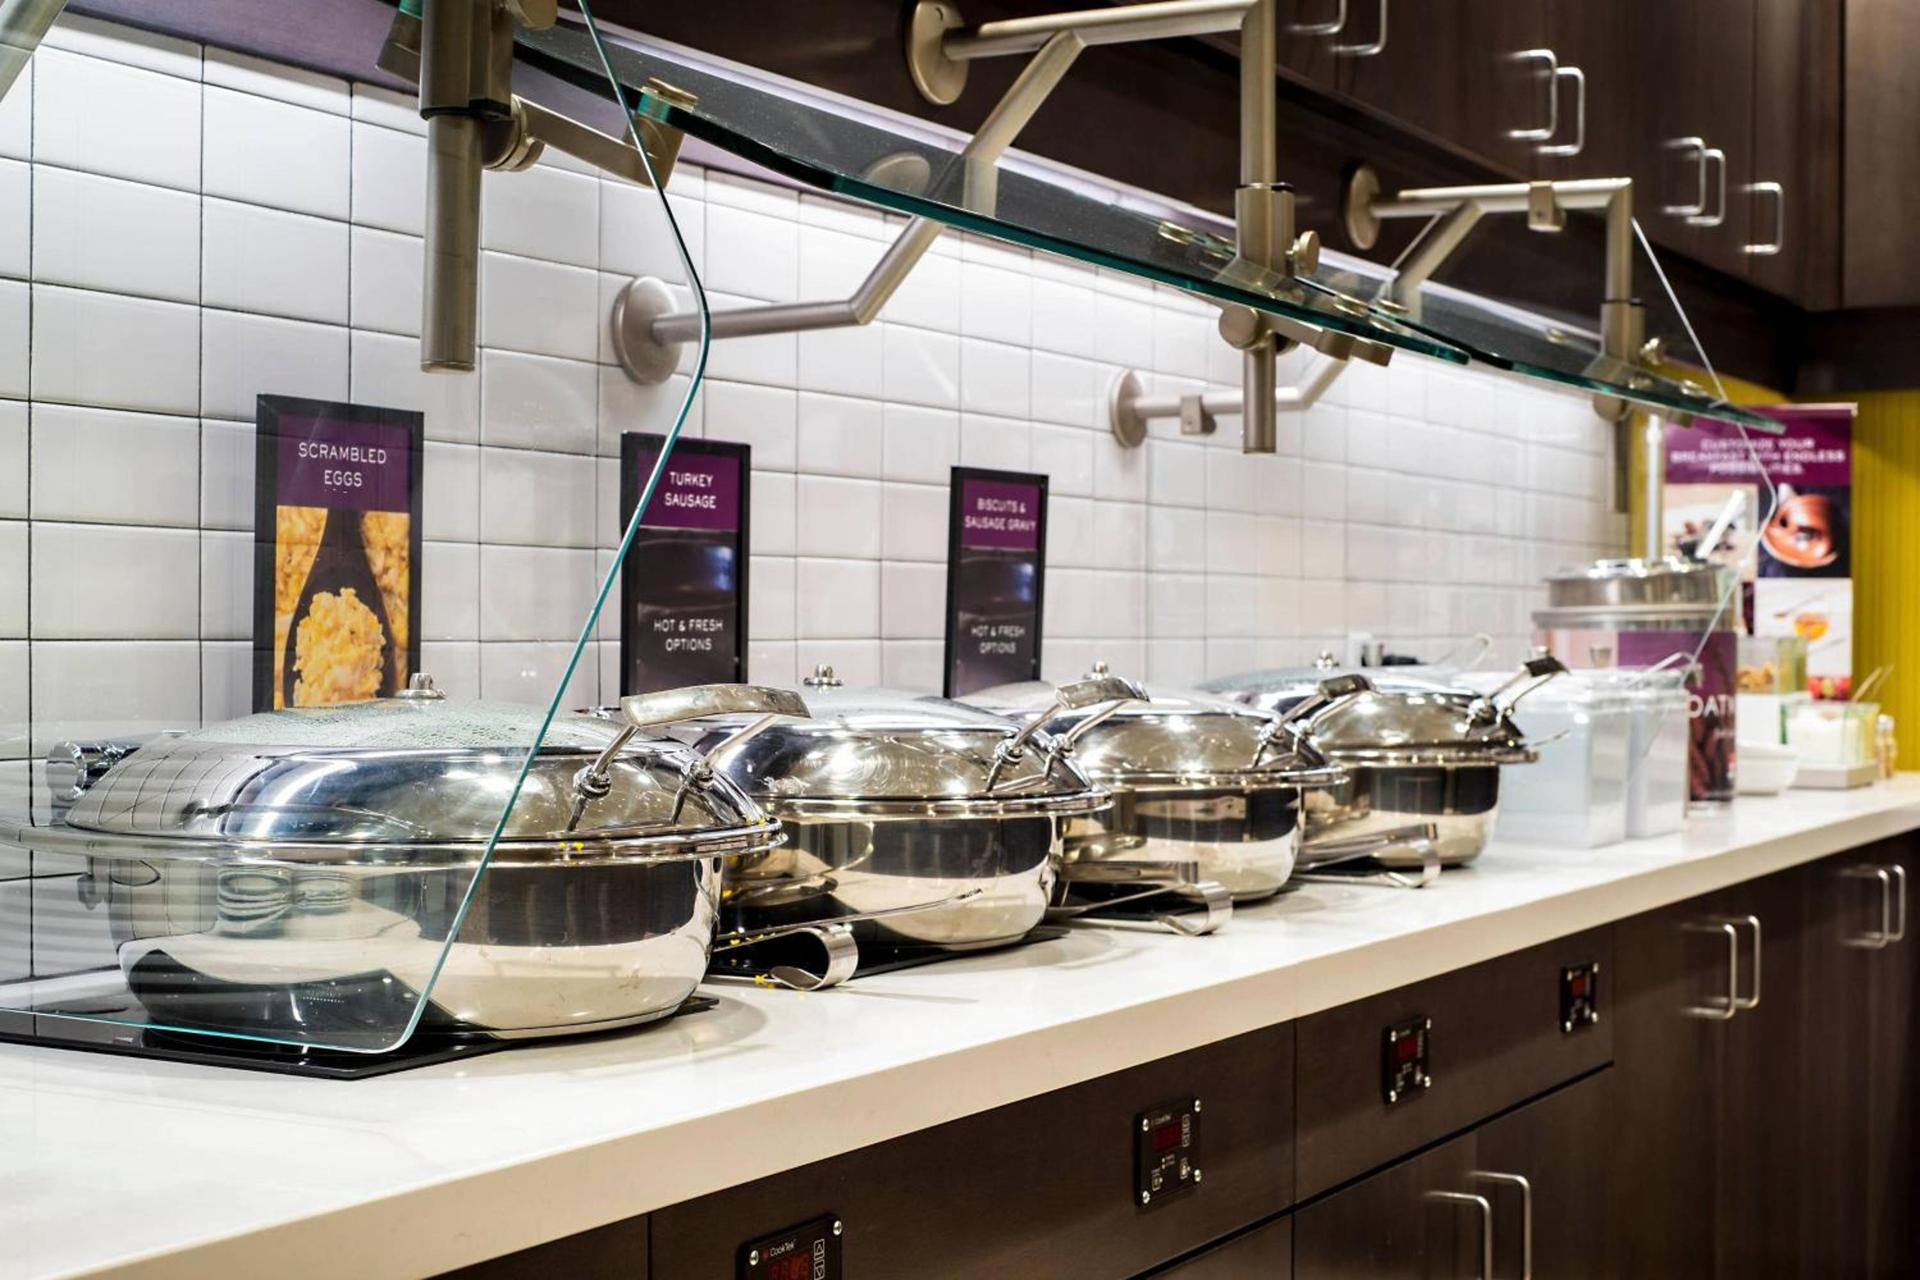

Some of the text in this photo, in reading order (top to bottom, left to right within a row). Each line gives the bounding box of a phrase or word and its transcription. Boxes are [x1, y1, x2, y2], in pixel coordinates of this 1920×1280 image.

[298, 442, 387, 465] SCRAMBLED
[1783, 449, 1846, 462] ENDLESS
[324, 470, 363, 488] EGGS
[669, 471, 713, 487] TURKEY
[664, 492, 717, 509] SAUSAGE
[977, 498, 1026, 514] BISCUITS &
[964, 515, 1037, 532] SAUSAGE GRAVY
[653, 619, 724, 632] HOT & FRESH
[971, 625, 1025, 637] HOT & FRESH
[665, 638, 712, 651] OPTIONS
[979, 641, 1017, 654] OPTIONS
